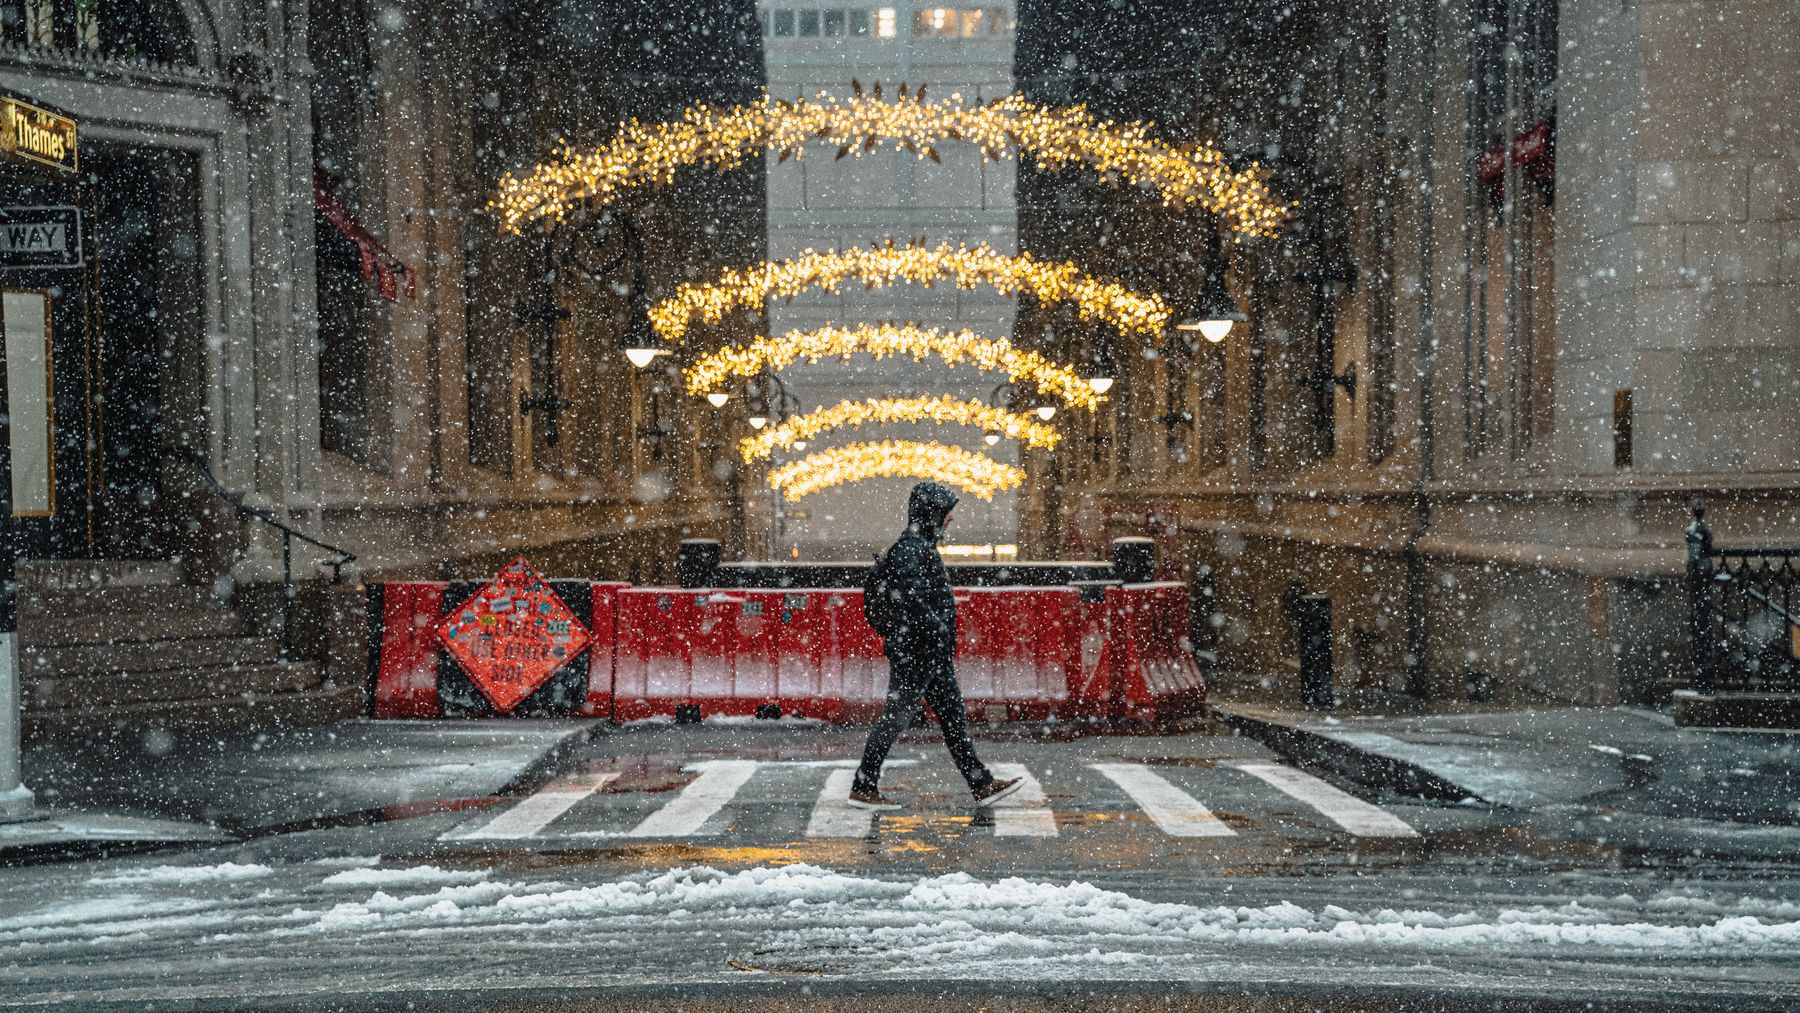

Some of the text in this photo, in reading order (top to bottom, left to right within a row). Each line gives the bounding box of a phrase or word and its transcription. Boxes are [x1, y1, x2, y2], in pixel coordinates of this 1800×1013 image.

[17, 113, 65, 161] Thames
[7, 226, 57, 248] WAY
[471, 639, 496, 657] USE
[504, 642, 551, 660] OTHER
[491, 664, 523, 682] SIDE
